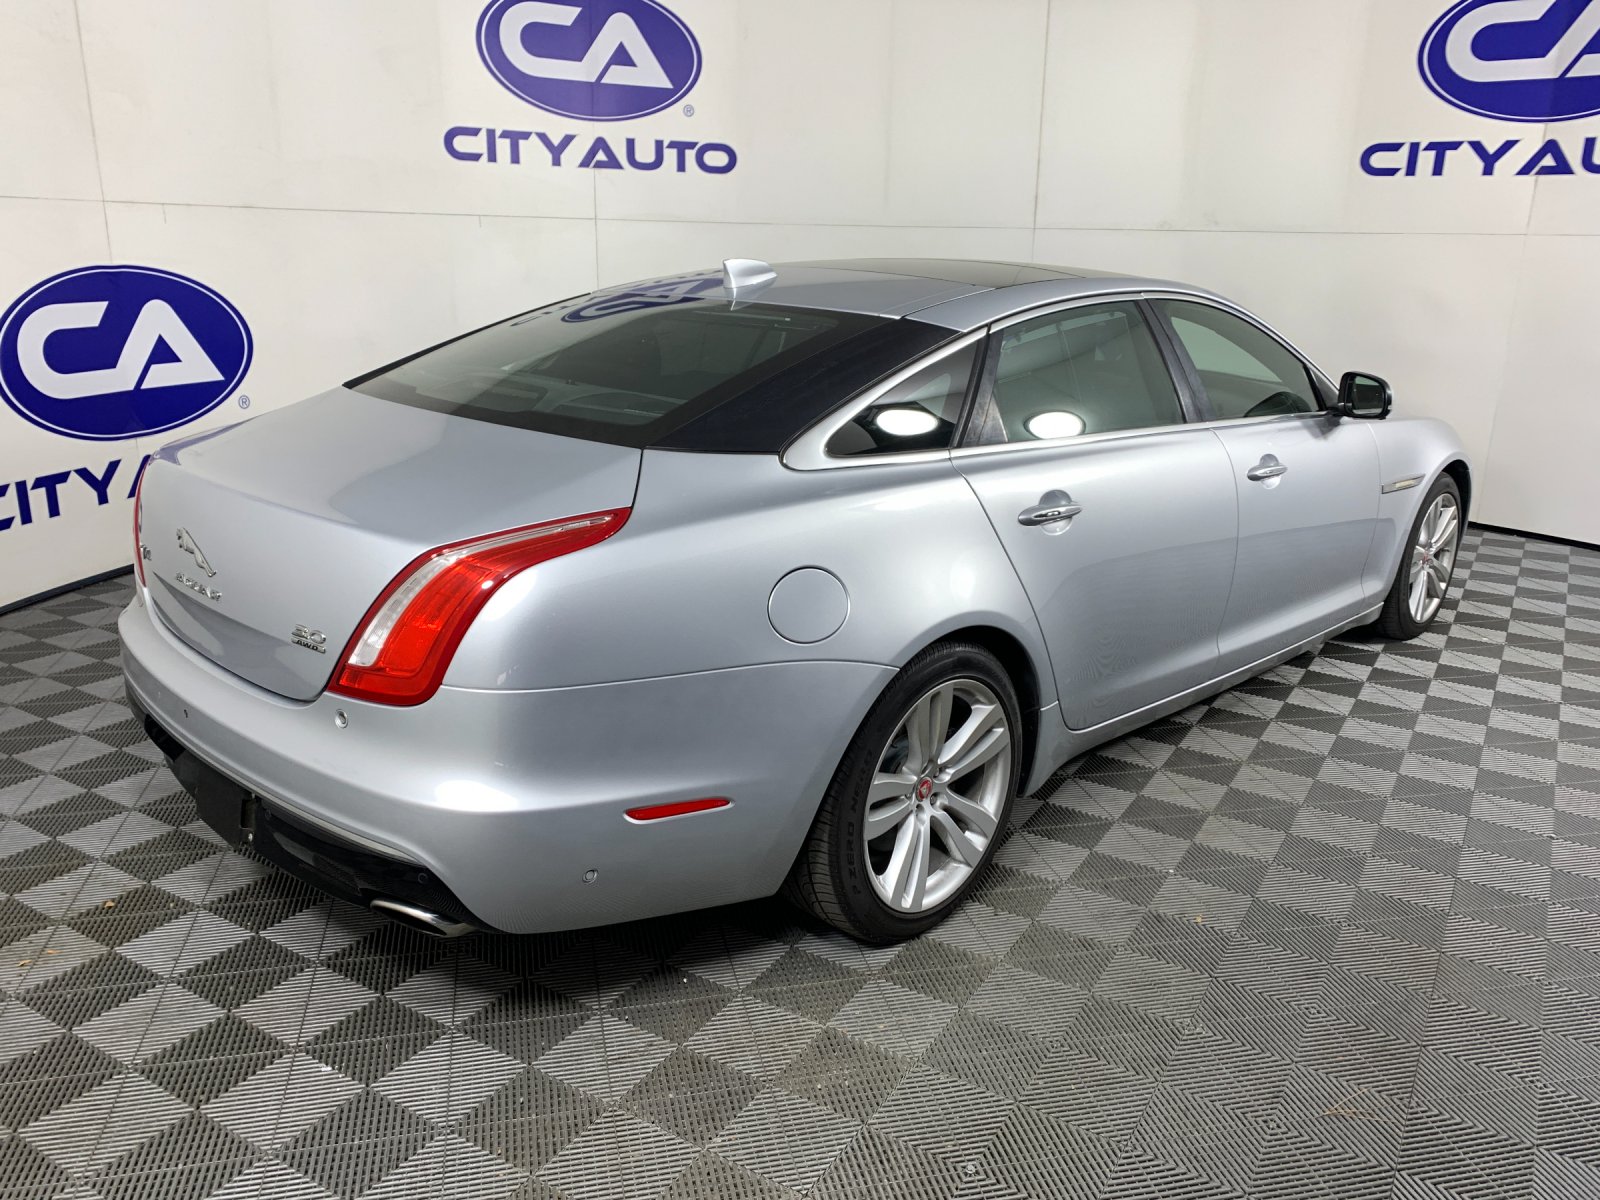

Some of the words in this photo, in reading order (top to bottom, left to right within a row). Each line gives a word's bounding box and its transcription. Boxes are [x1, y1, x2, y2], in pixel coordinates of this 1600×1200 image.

[499, 1, 675, 89] CA
[17, 299, 225, 399] CA
[847, 821, 858, 879] ZERO
